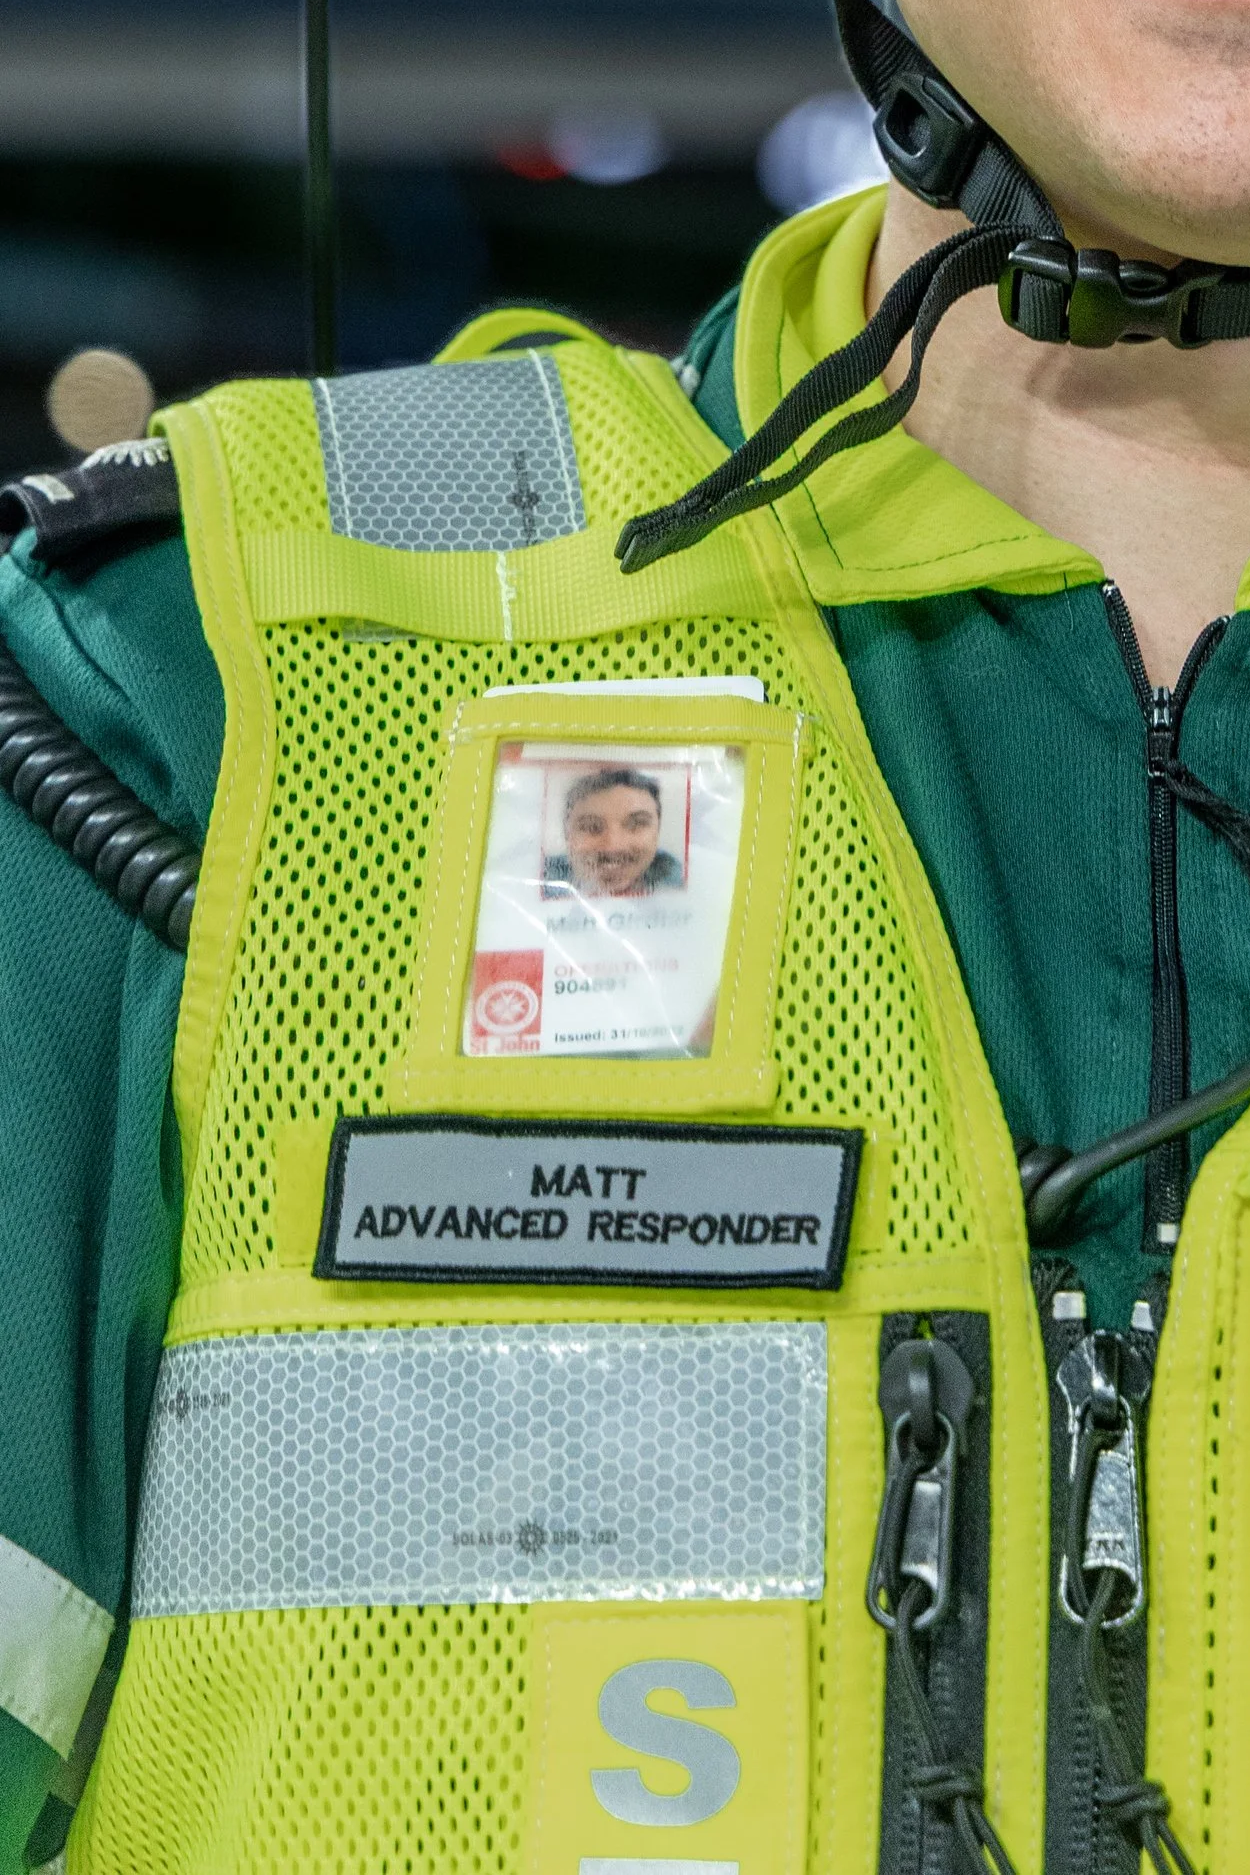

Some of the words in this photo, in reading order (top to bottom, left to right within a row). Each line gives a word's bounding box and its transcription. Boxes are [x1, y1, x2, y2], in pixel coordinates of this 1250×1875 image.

[531, 1165, 648, 1199] MATT
[353, 1205, 569, 1239] ADVANCED
[587, 1209, 820, 1246] RESPONDER
[579, 1658, 742, 1875] S
